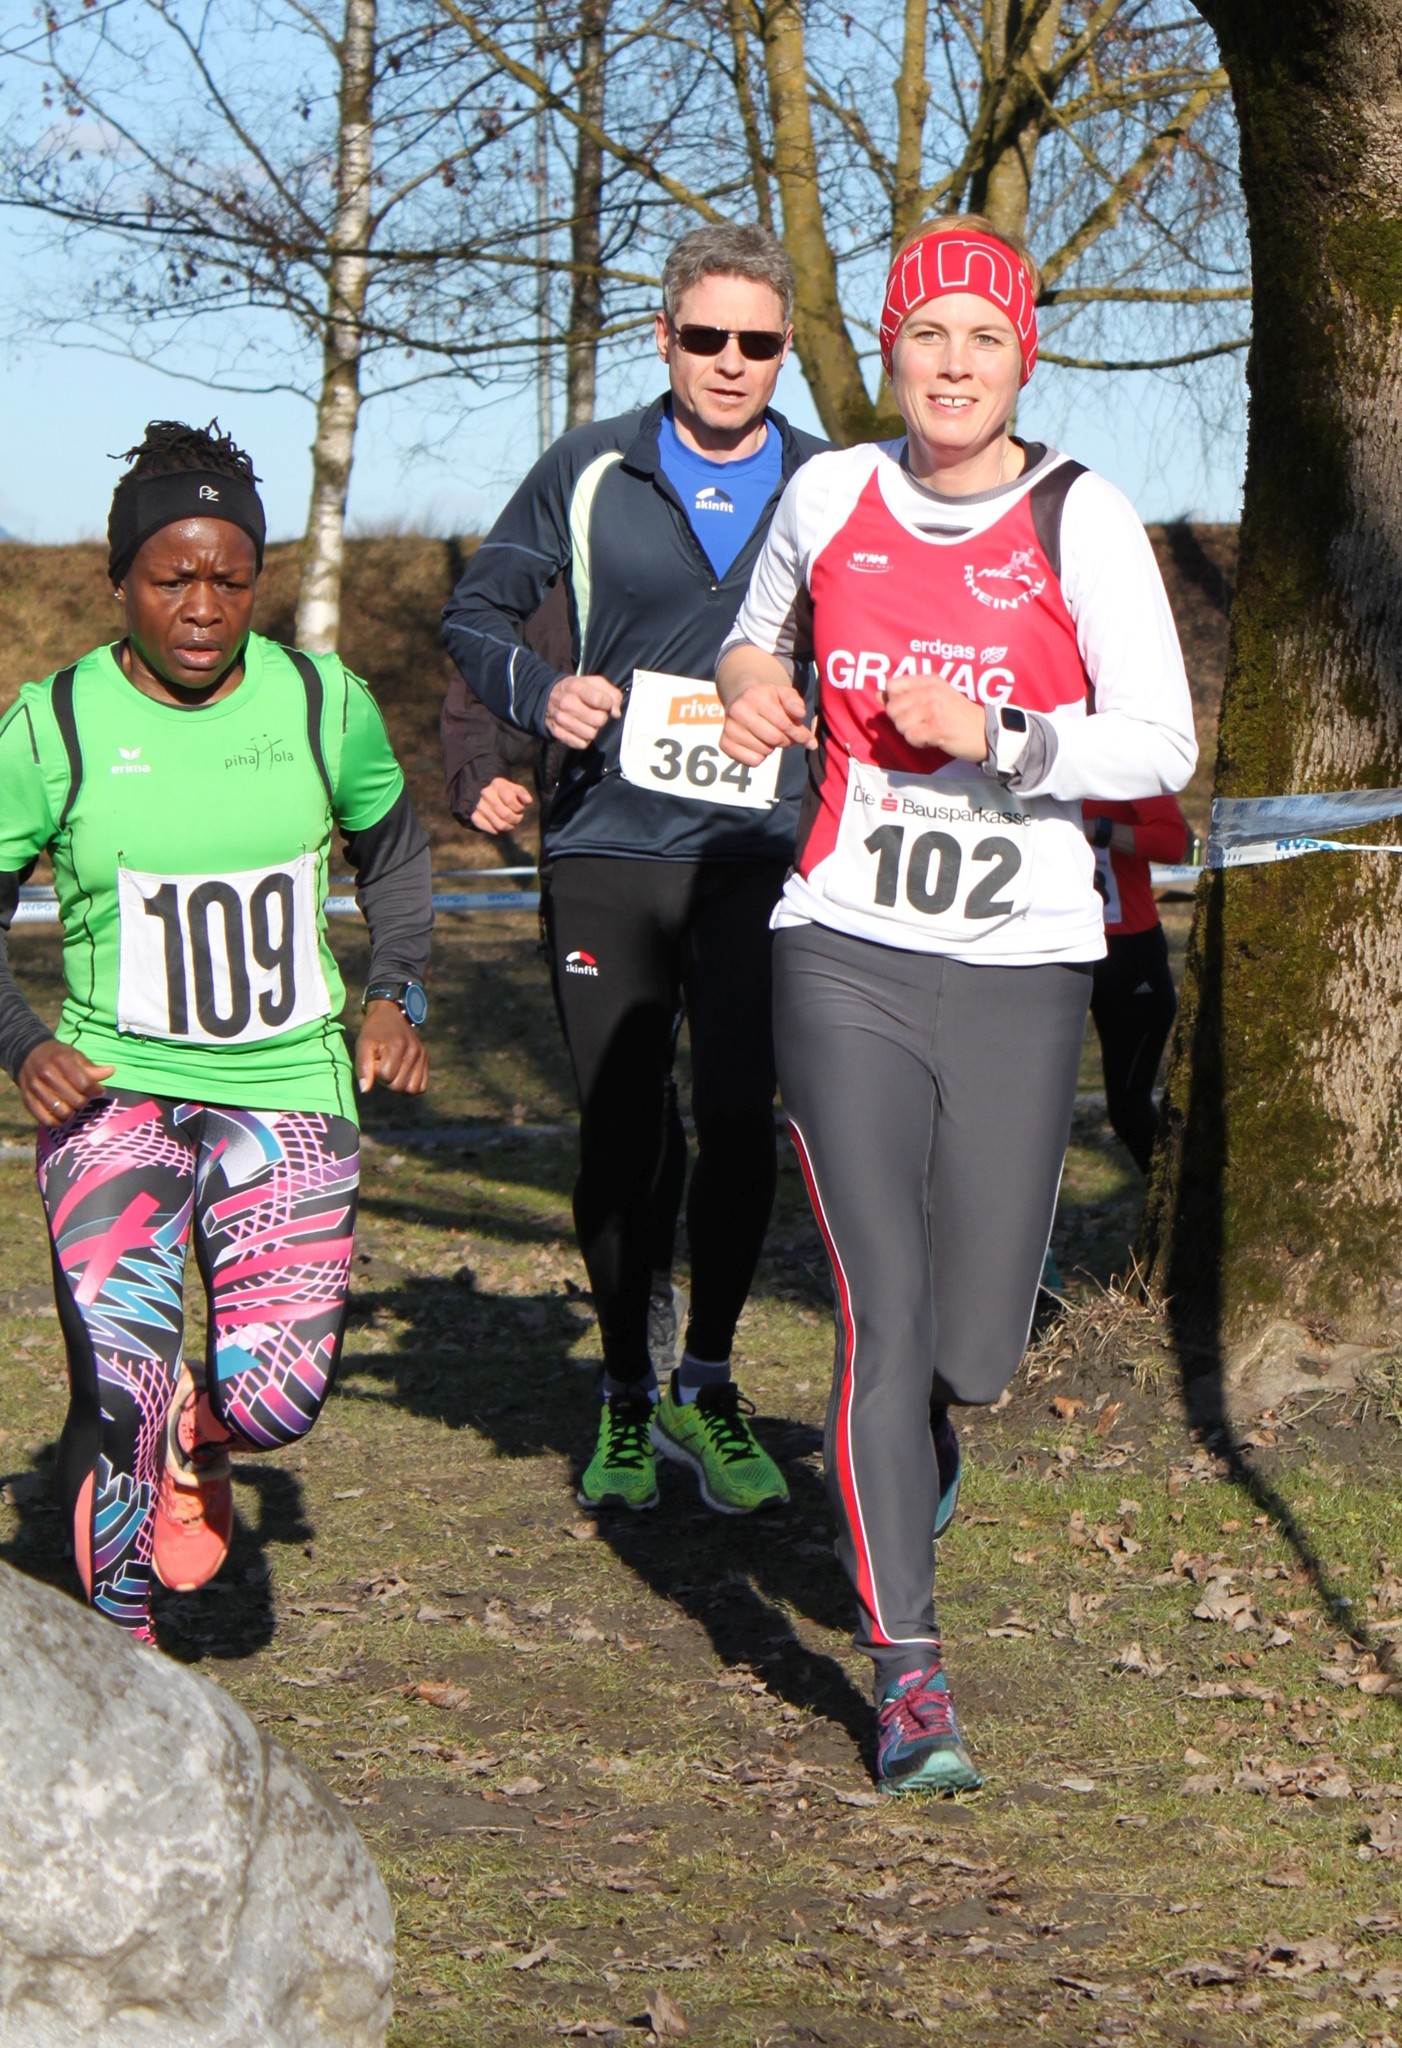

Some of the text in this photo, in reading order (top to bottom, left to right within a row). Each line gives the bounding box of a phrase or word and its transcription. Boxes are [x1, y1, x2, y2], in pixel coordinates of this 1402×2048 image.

[695, 500, 734, 514] skinfit
[964, 564, 1047, 610] RHEINTAL
[910, 639, 975, 660] erdgas
[111, 764, 151, 775] erima
[650, 738, 752, 793] 364
[853, 785, 875, 806] Die
[902, 798, 1032, 827] Bausparkasse
[863, 824, 1022, 919] 102
[143, 872, 296, 1038] 109
[566, 963, 598, 976] skinfit
